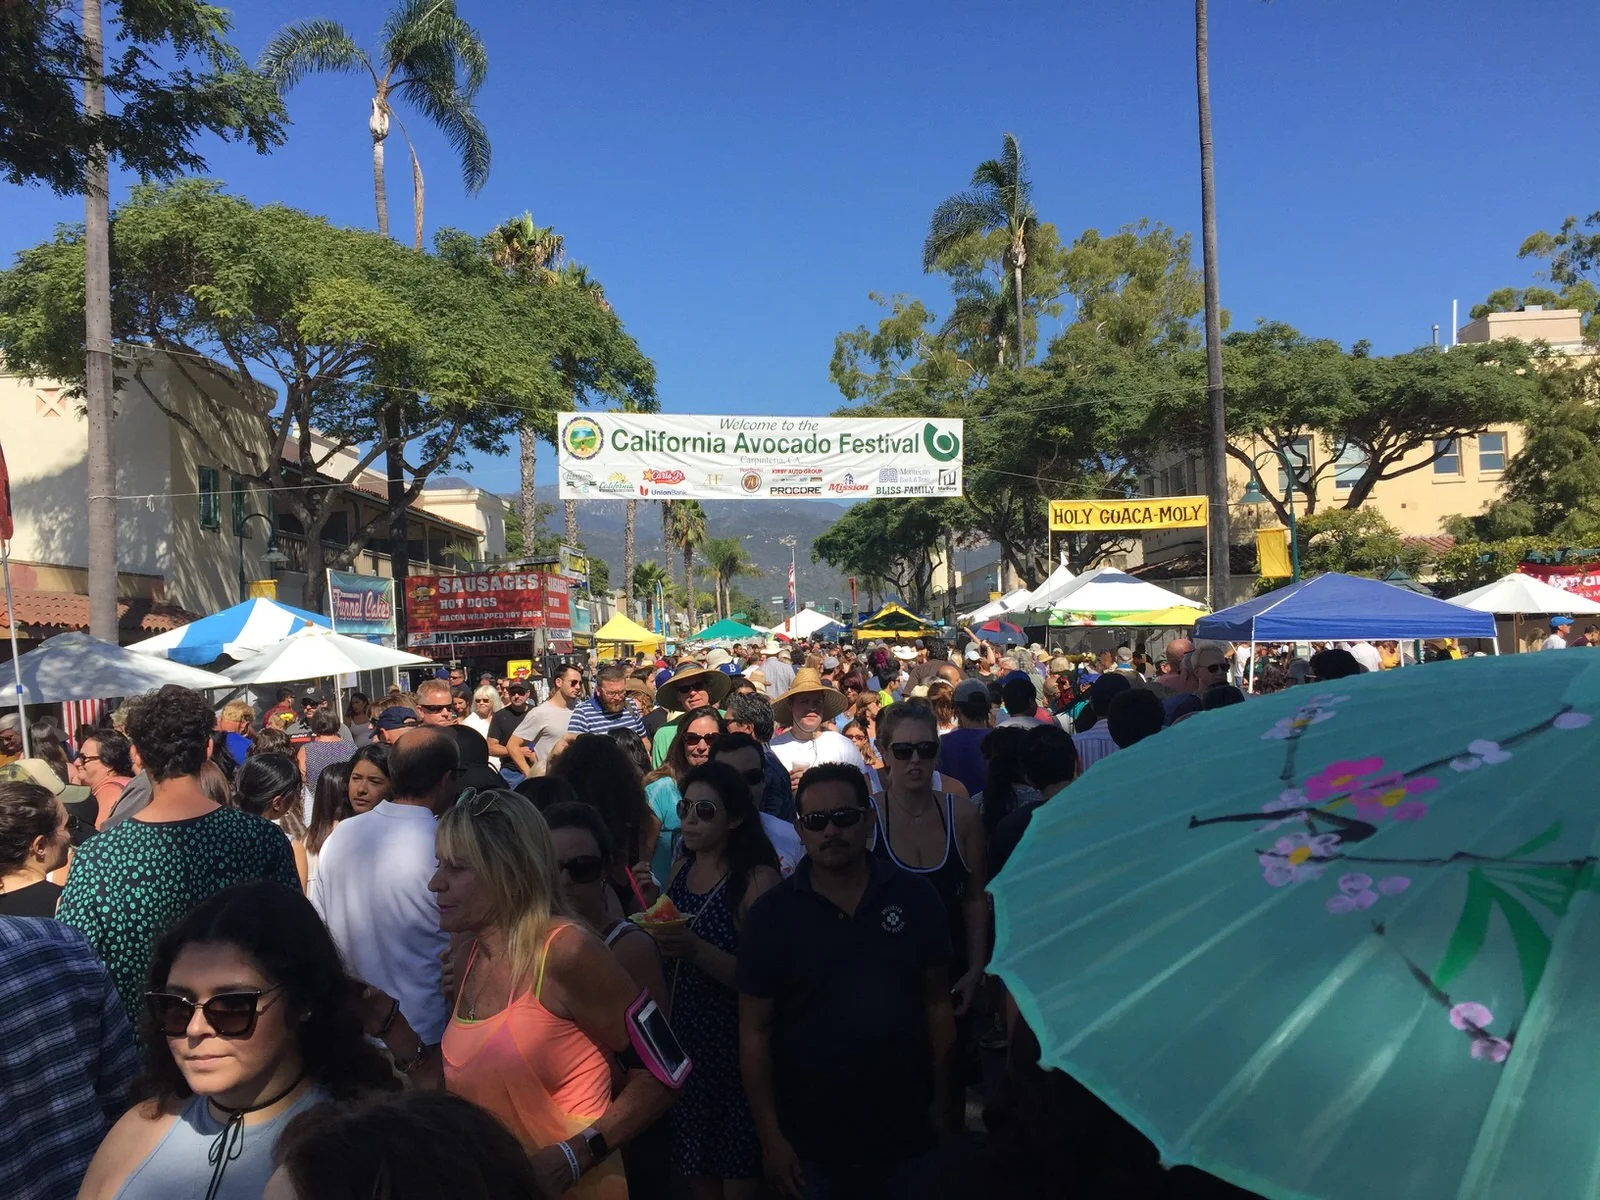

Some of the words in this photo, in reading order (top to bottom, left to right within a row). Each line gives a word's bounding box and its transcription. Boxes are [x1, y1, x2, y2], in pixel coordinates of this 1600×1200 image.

[720, 418, 777, 431] Welcome
[781, 420, 794, 431] to
[799, 420, 819, 431] the
[611, 428, 725, 454] California
[733, 431, 831, 454] Avocado
[839, 433, 919, 454] Festival
[788, 456, 800, 464] CA
[770, 487, 822, 495] PROCORE
[828, 483, 869, 493] Mission
[876, 487, 902, 495] BLISS
[904, 486, 935, 494] FAMILY
[1053, 508, 1093, 525] HOLY
[1099, 504, 1203, 524] GUACA-MOLY
[438, 573, 539, 594] SAUSAGES
[333, 588, 363, 618] Funnel
[365, 590, 391, 618] Cakes
[440, 598, 464, 609] HOT
[467, 597, 497, 608] DOGS
[440, 614, 466, 622] BACON
[467, 611, 505, 620] WRAPPED
[522, 610, 542, 618] DOGS
[729, 664, 737, 673] B
